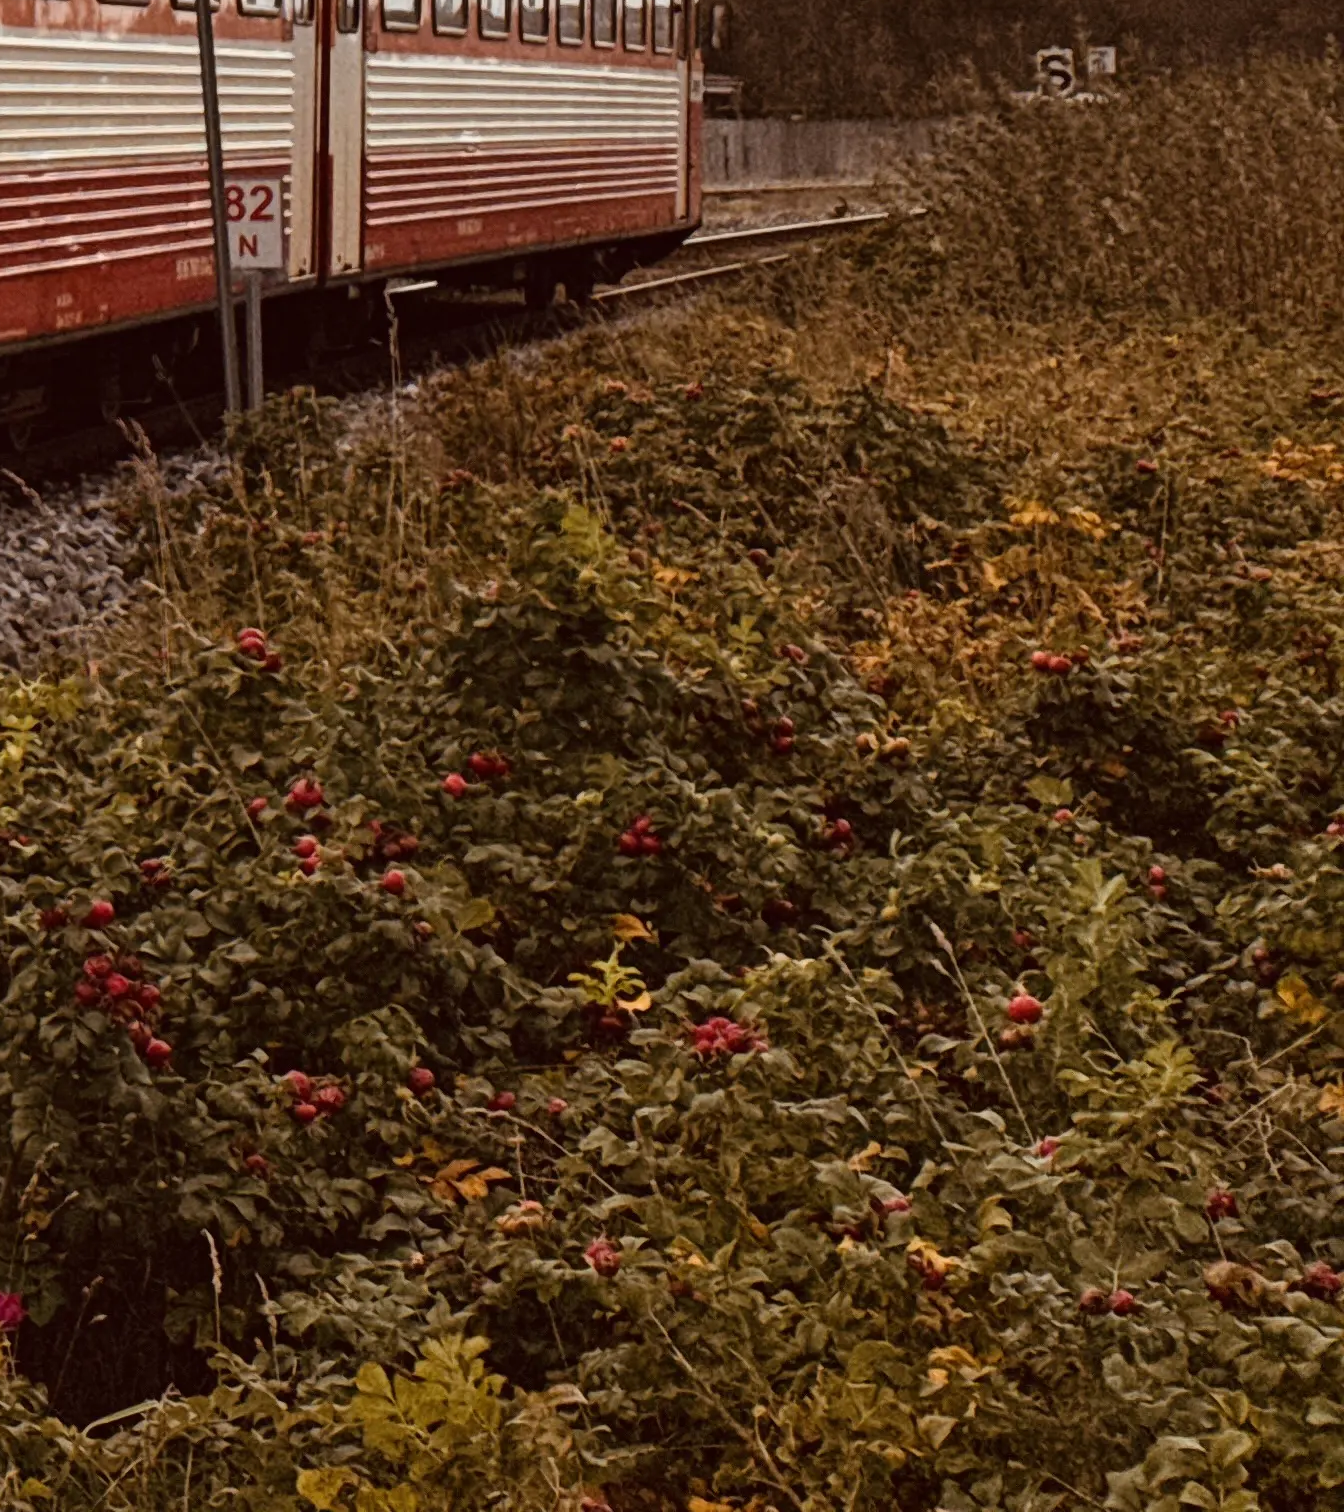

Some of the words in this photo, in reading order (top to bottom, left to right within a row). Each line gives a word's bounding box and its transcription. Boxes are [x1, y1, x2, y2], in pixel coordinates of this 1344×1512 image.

[1040, 54, 1073, 94] S
[224, 184, 275, 222] 82
[238, 234, 258, 257] N
